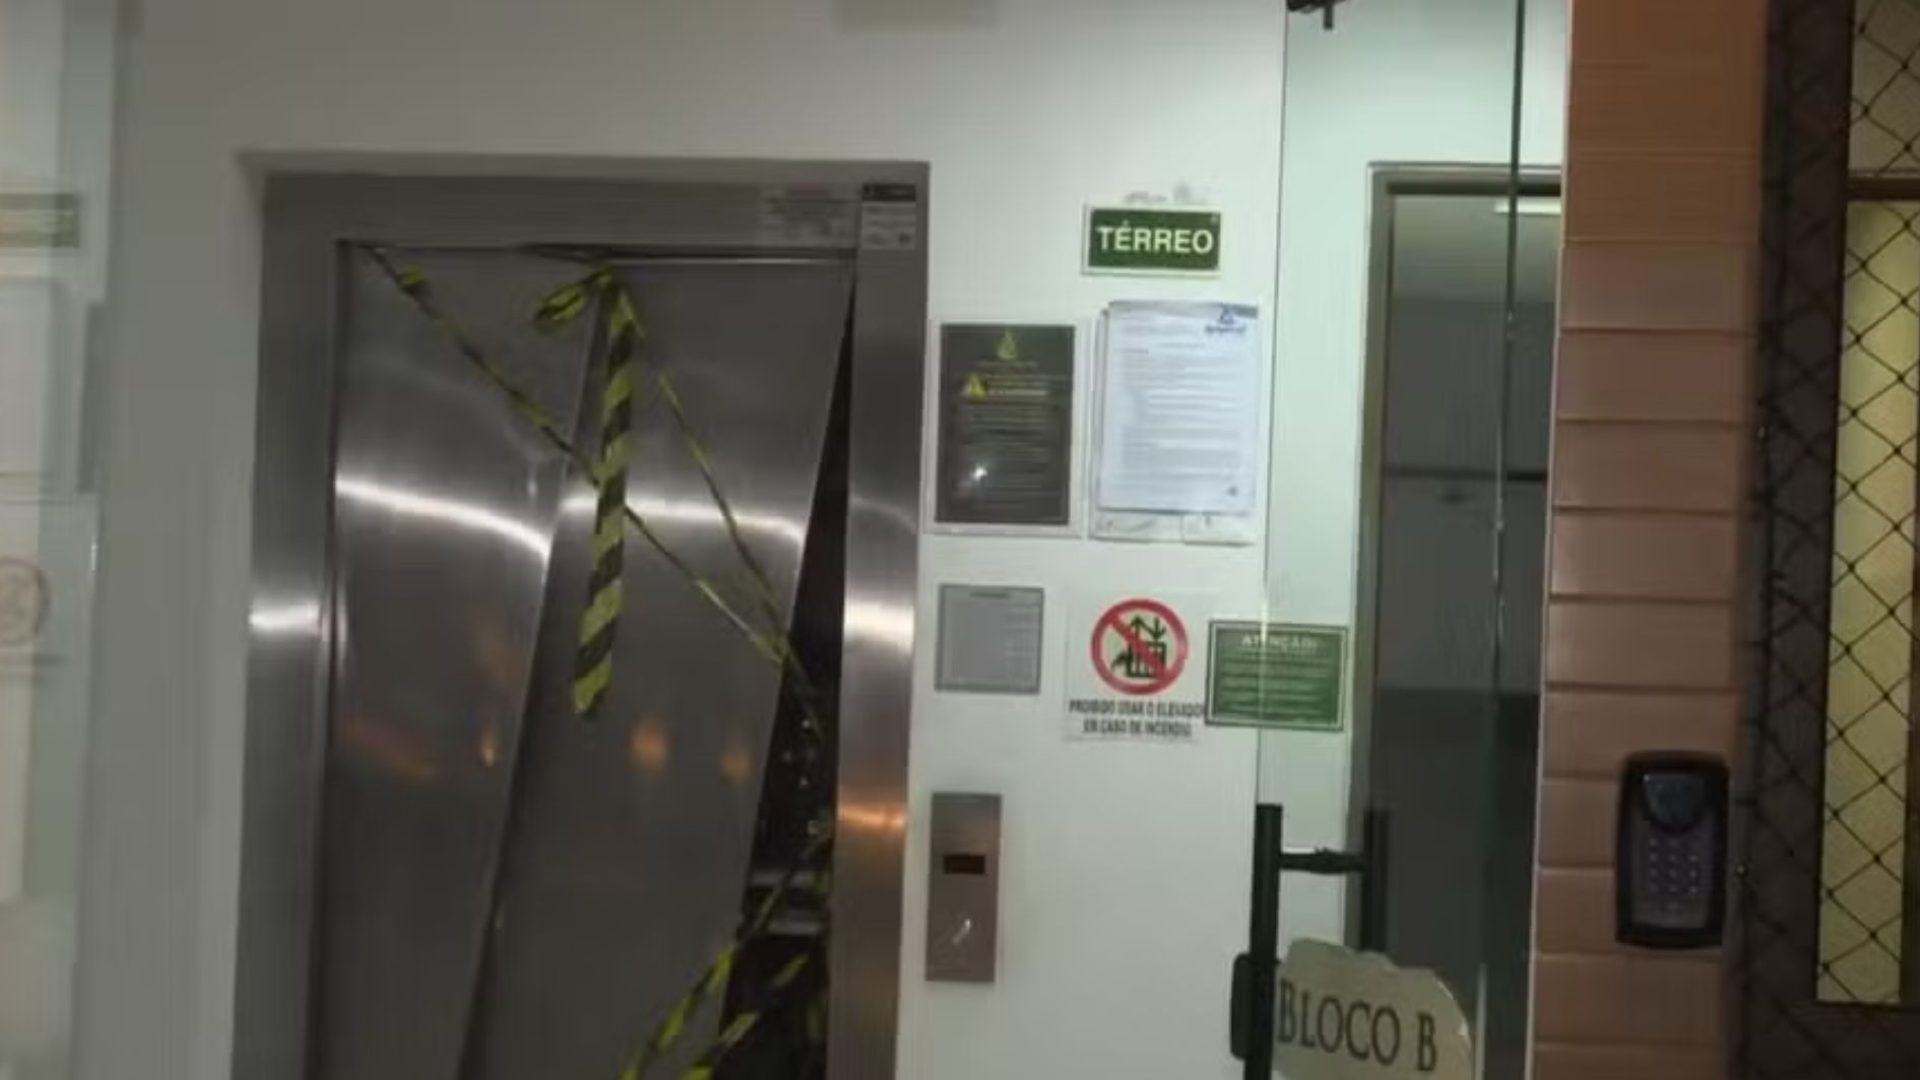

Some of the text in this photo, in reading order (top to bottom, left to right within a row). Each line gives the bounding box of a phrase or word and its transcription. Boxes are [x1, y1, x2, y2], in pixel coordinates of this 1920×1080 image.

[1097, 220, 1213, 254] TÉRREO
[1069, 698, 1115, 714] PROIBIDO
[1118, 699, 1143, 715] USAR
[1146, 702, 1153, 716] O
[1083, 719, 1097, 733] EM
[1101, 720, 1127, 735] CASO
[1131, 721, 1142, 735] DE
[1277, 978, 1437, 1072] BLOCO B
